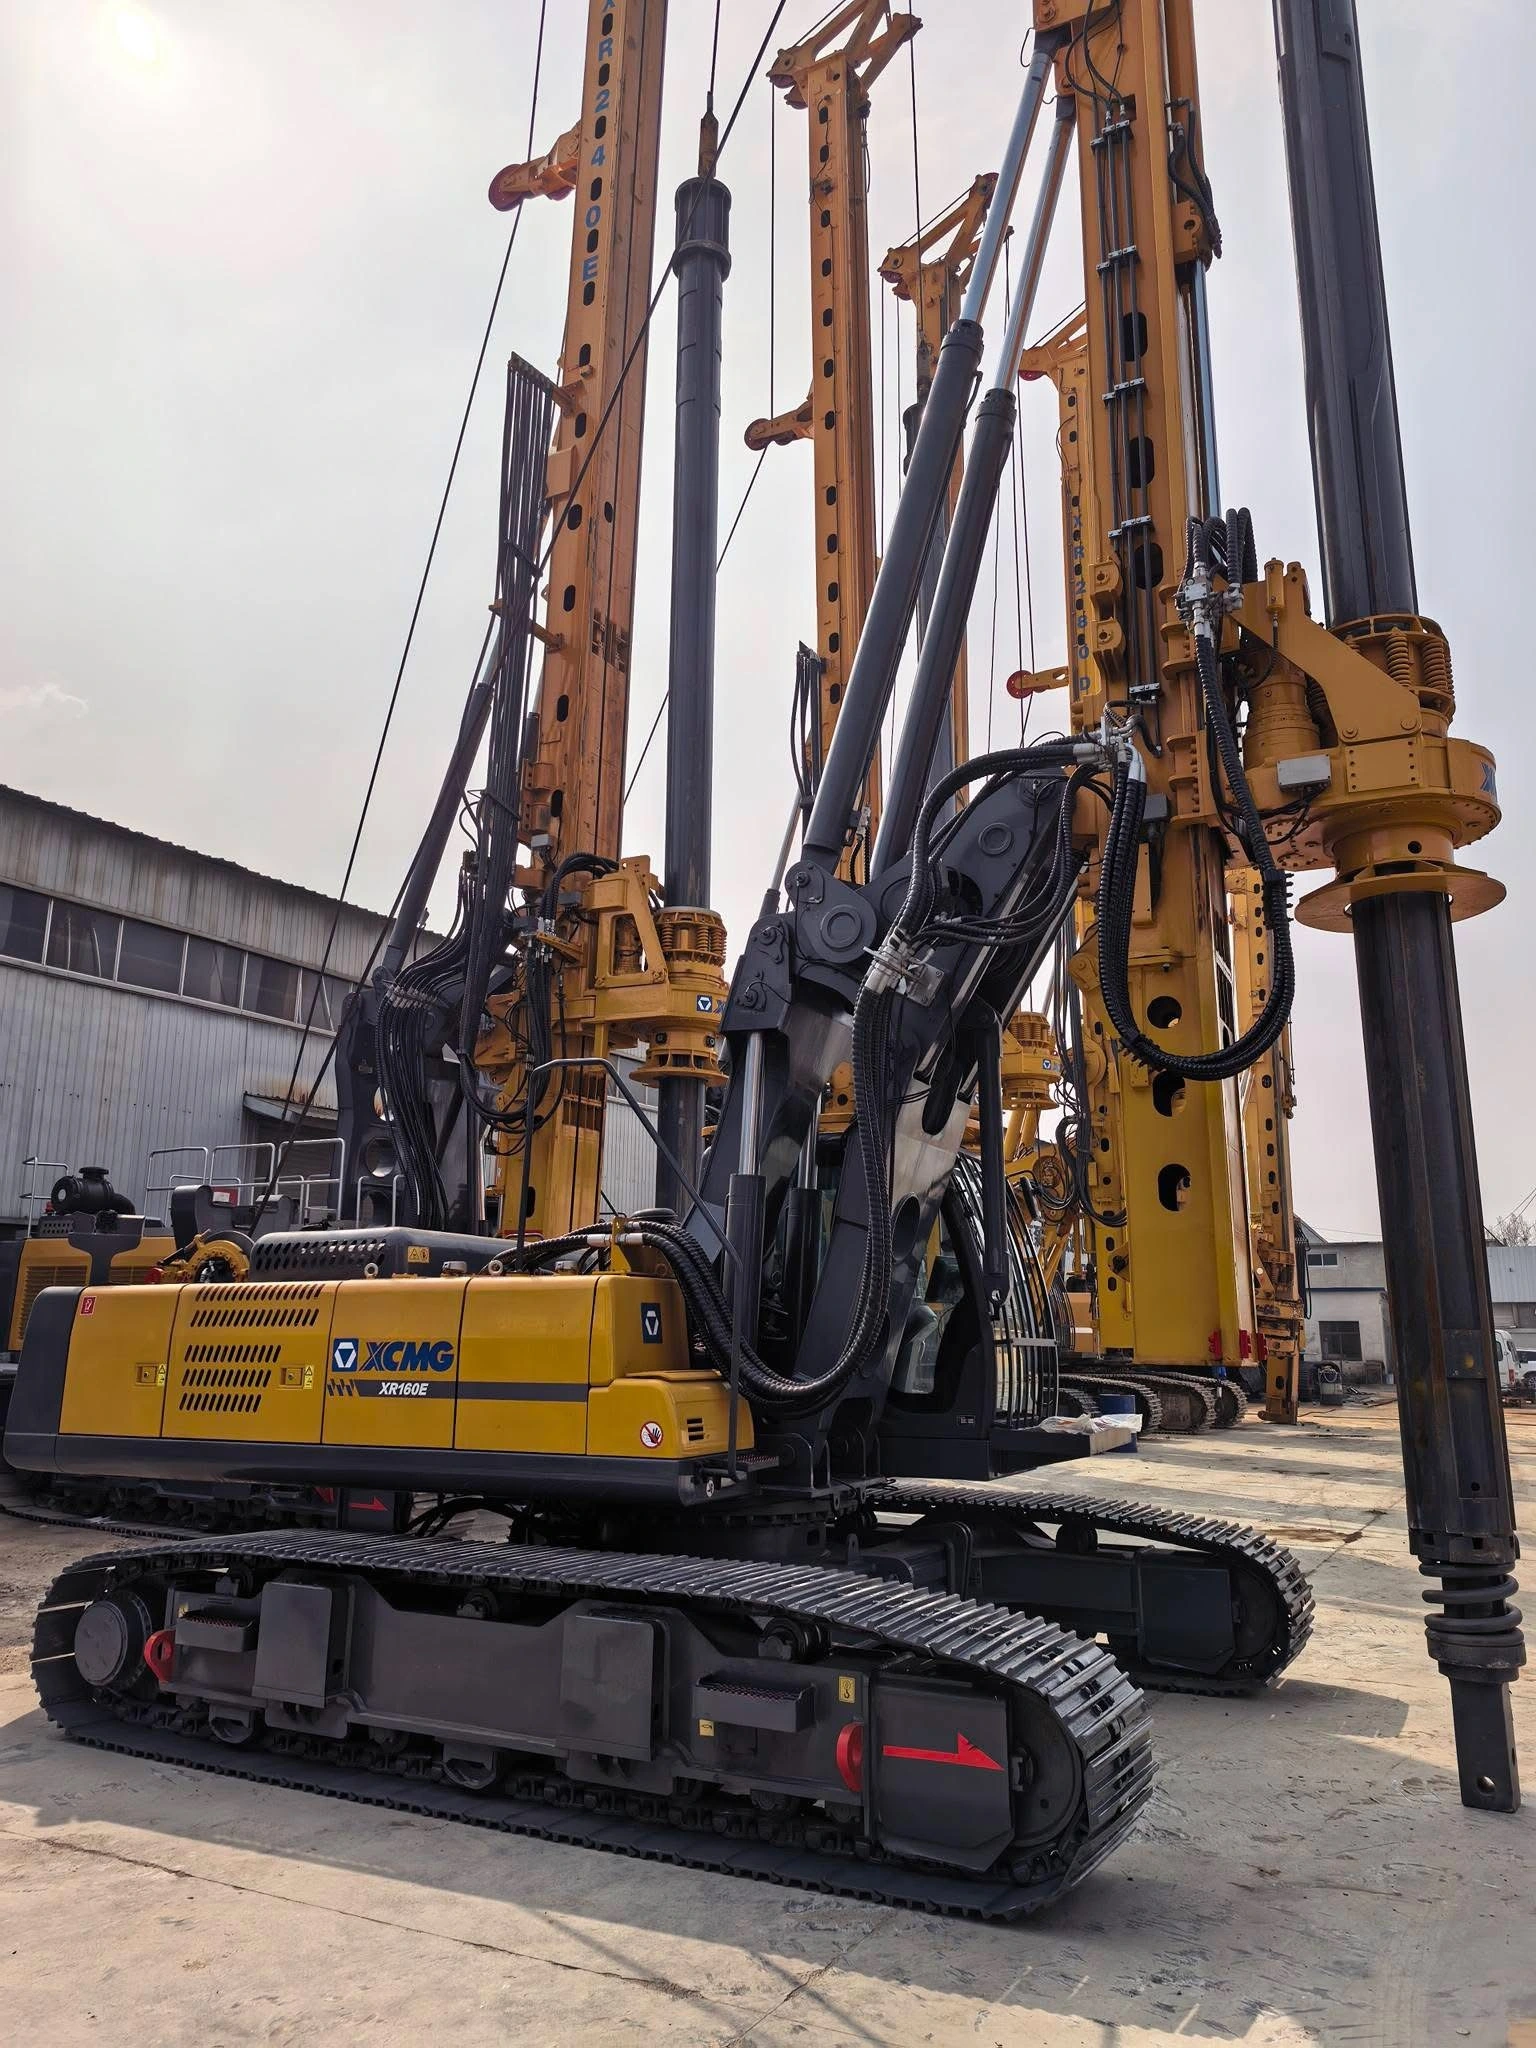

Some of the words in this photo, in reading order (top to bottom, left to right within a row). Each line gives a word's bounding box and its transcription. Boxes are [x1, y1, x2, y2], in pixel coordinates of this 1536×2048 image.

[1073, 515, 1090, 691] XR280D
[359, 1341, 454, 1371] XCMG
[379, 1382, 428, 1395] XR160E
